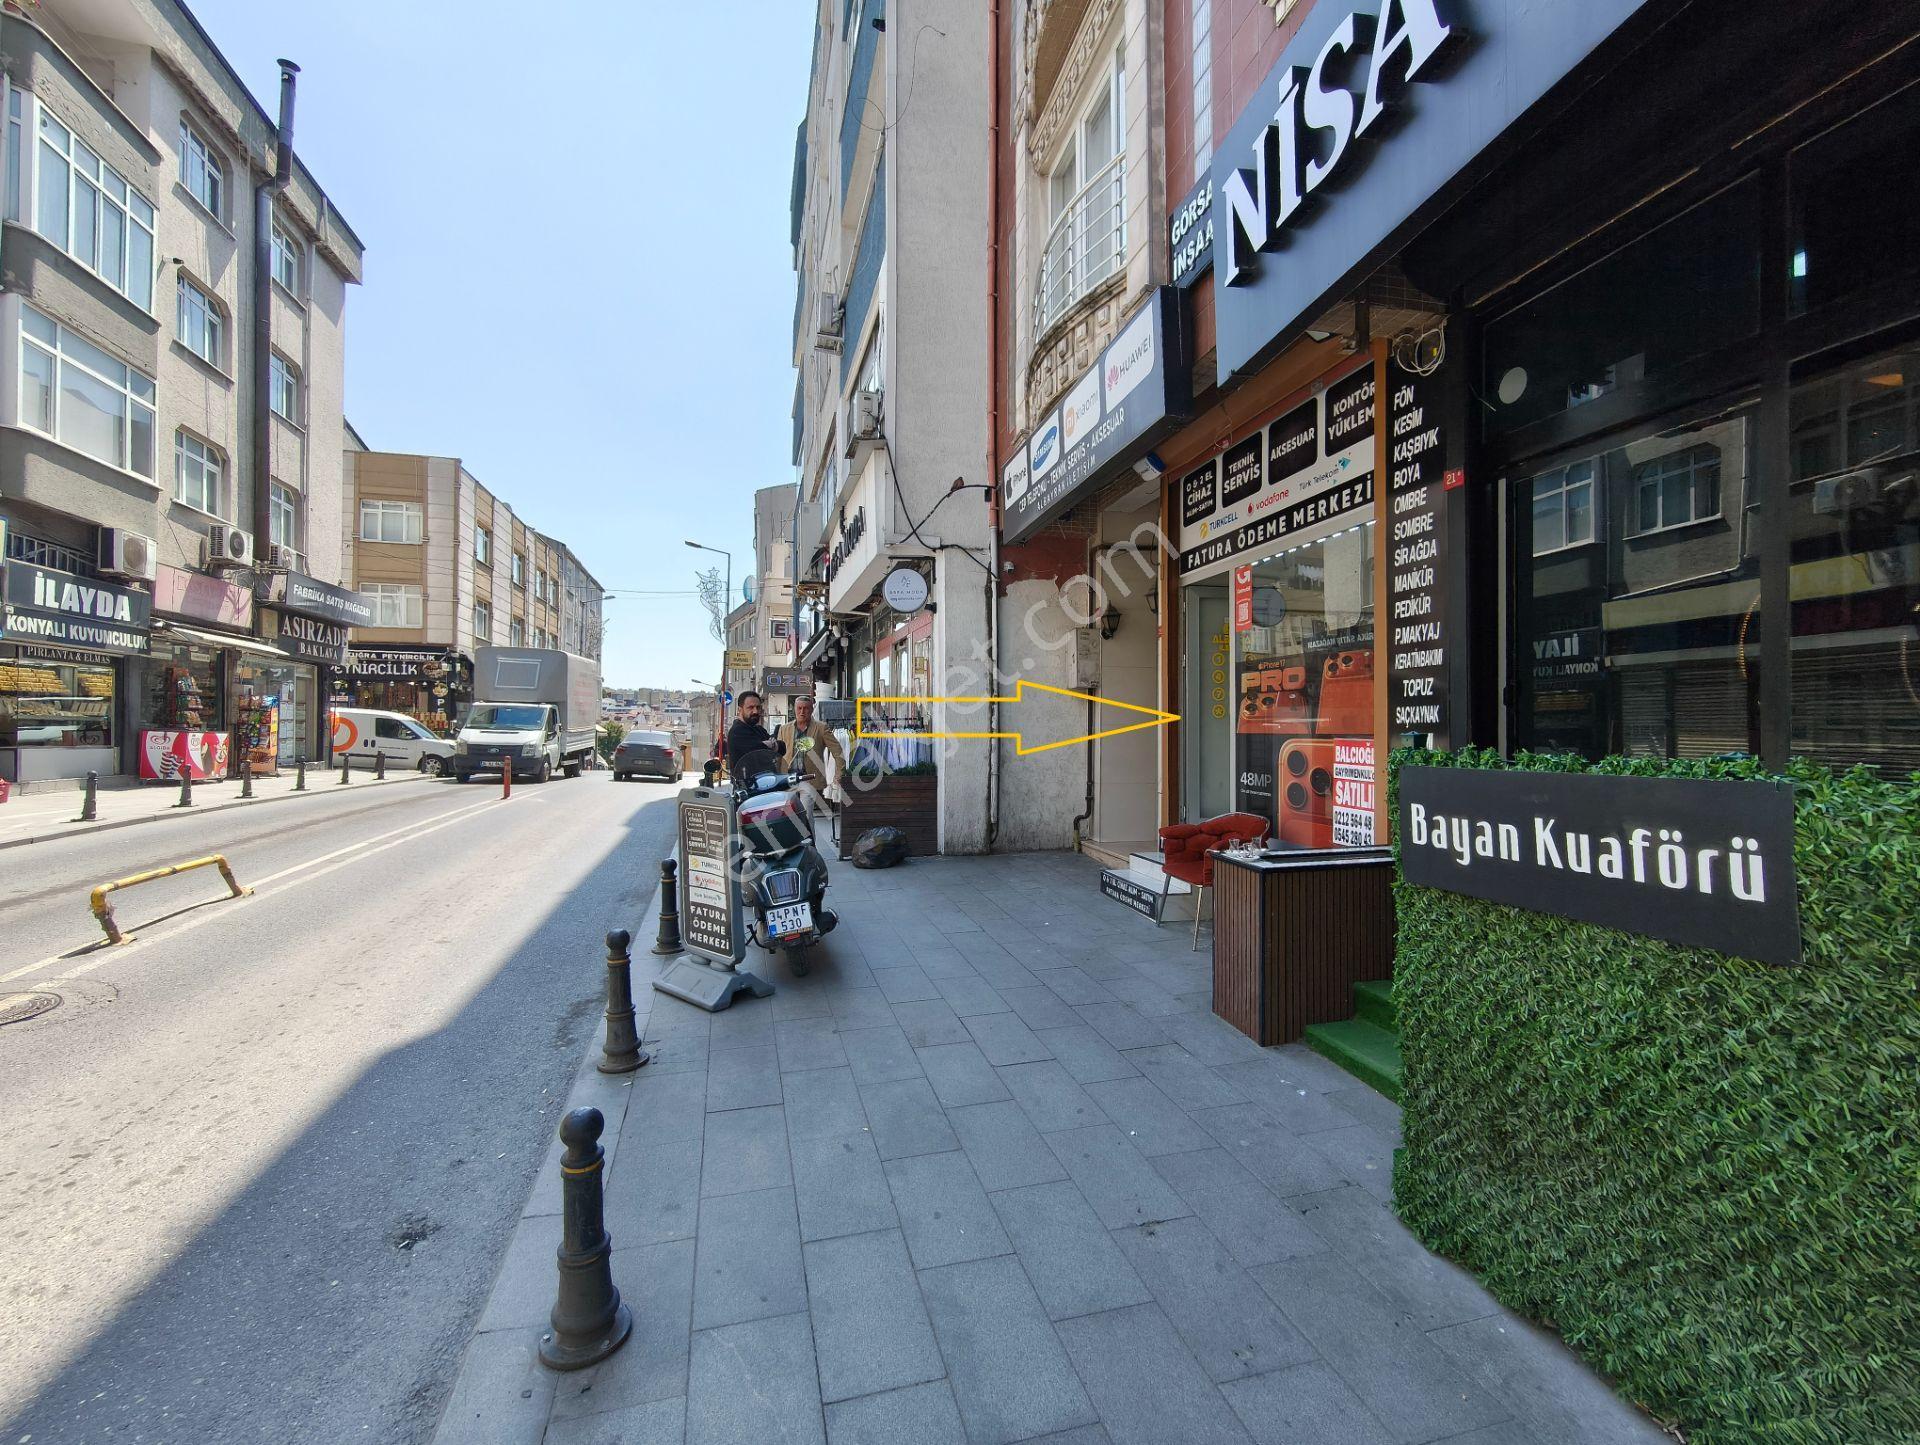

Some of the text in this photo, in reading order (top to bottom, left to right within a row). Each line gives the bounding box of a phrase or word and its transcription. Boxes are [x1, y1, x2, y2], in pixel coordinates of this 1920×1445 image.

[1222, 0, 1450, 286] NİSA
[1118, 333, 1151, 375] HUAWEI
[1394, 384, 1415, 411] FÖN
[1091, 408, 1125, 448] AKSESUAR
[1394, 406, 1423, 437] KESİM
[1270, 427, 1315, 462] AKSESUAR
[1393, 427, 1439, 463] KAŞBIYIK
[1205, 470, 1213, 481] EL
[1228, 452, 1255, 474] TEKNİK
[1393, 462, 1421, 489] BOYA
[1223, 463, 1260, 494] SERVİS
[1187, 483, 1212, 505] CİHAZ
[1255, 488, 1290, 511] vodafone
[1394, 487, 1428, 515] OMBRE
[1187, 475, 1373, 569] FATURA ÖDEME MERKEZİ
[1209, 512, 1238, 531] TURKCELL
[1394, 512, 1434, 541] SOMBRE
[1394, 565, 1434, 594] MANİKÜR
[34, 571, 131, 621] İLAYDA
[293, 583, 324, 603] FABRİKA
[345, 600, 371, 617] MAĞAZASI
[1394, 592, 1431, 619] PEDİKÜR
[7, 614, 148, 649] KONYALI KUYUMCULUK
[775, 623, 786, 637] E
[1394, 621, 1441, 645] P.MAKYAJ
[27, 646, 111, 664] PIRLANTA & ELMAS
[300, 643, 338, 660] BAKLAVA
[382, 652, 436, 661] PEYNİRCİLİK
[1241, 666, 1306, 693] PRO
[1403, 677, 1434, 698] TOPUZ
[1240, 771, 1272, 788] 48MP
[1411, 802, 1765, 903] Bayan Kuaförü
[690, 905, 727, 922] FATURA
[693, 917, 726, 935] ÖDEME
[781, 917, 802, 932] 530
[689, 930, 730, 950] MERKEZİ
